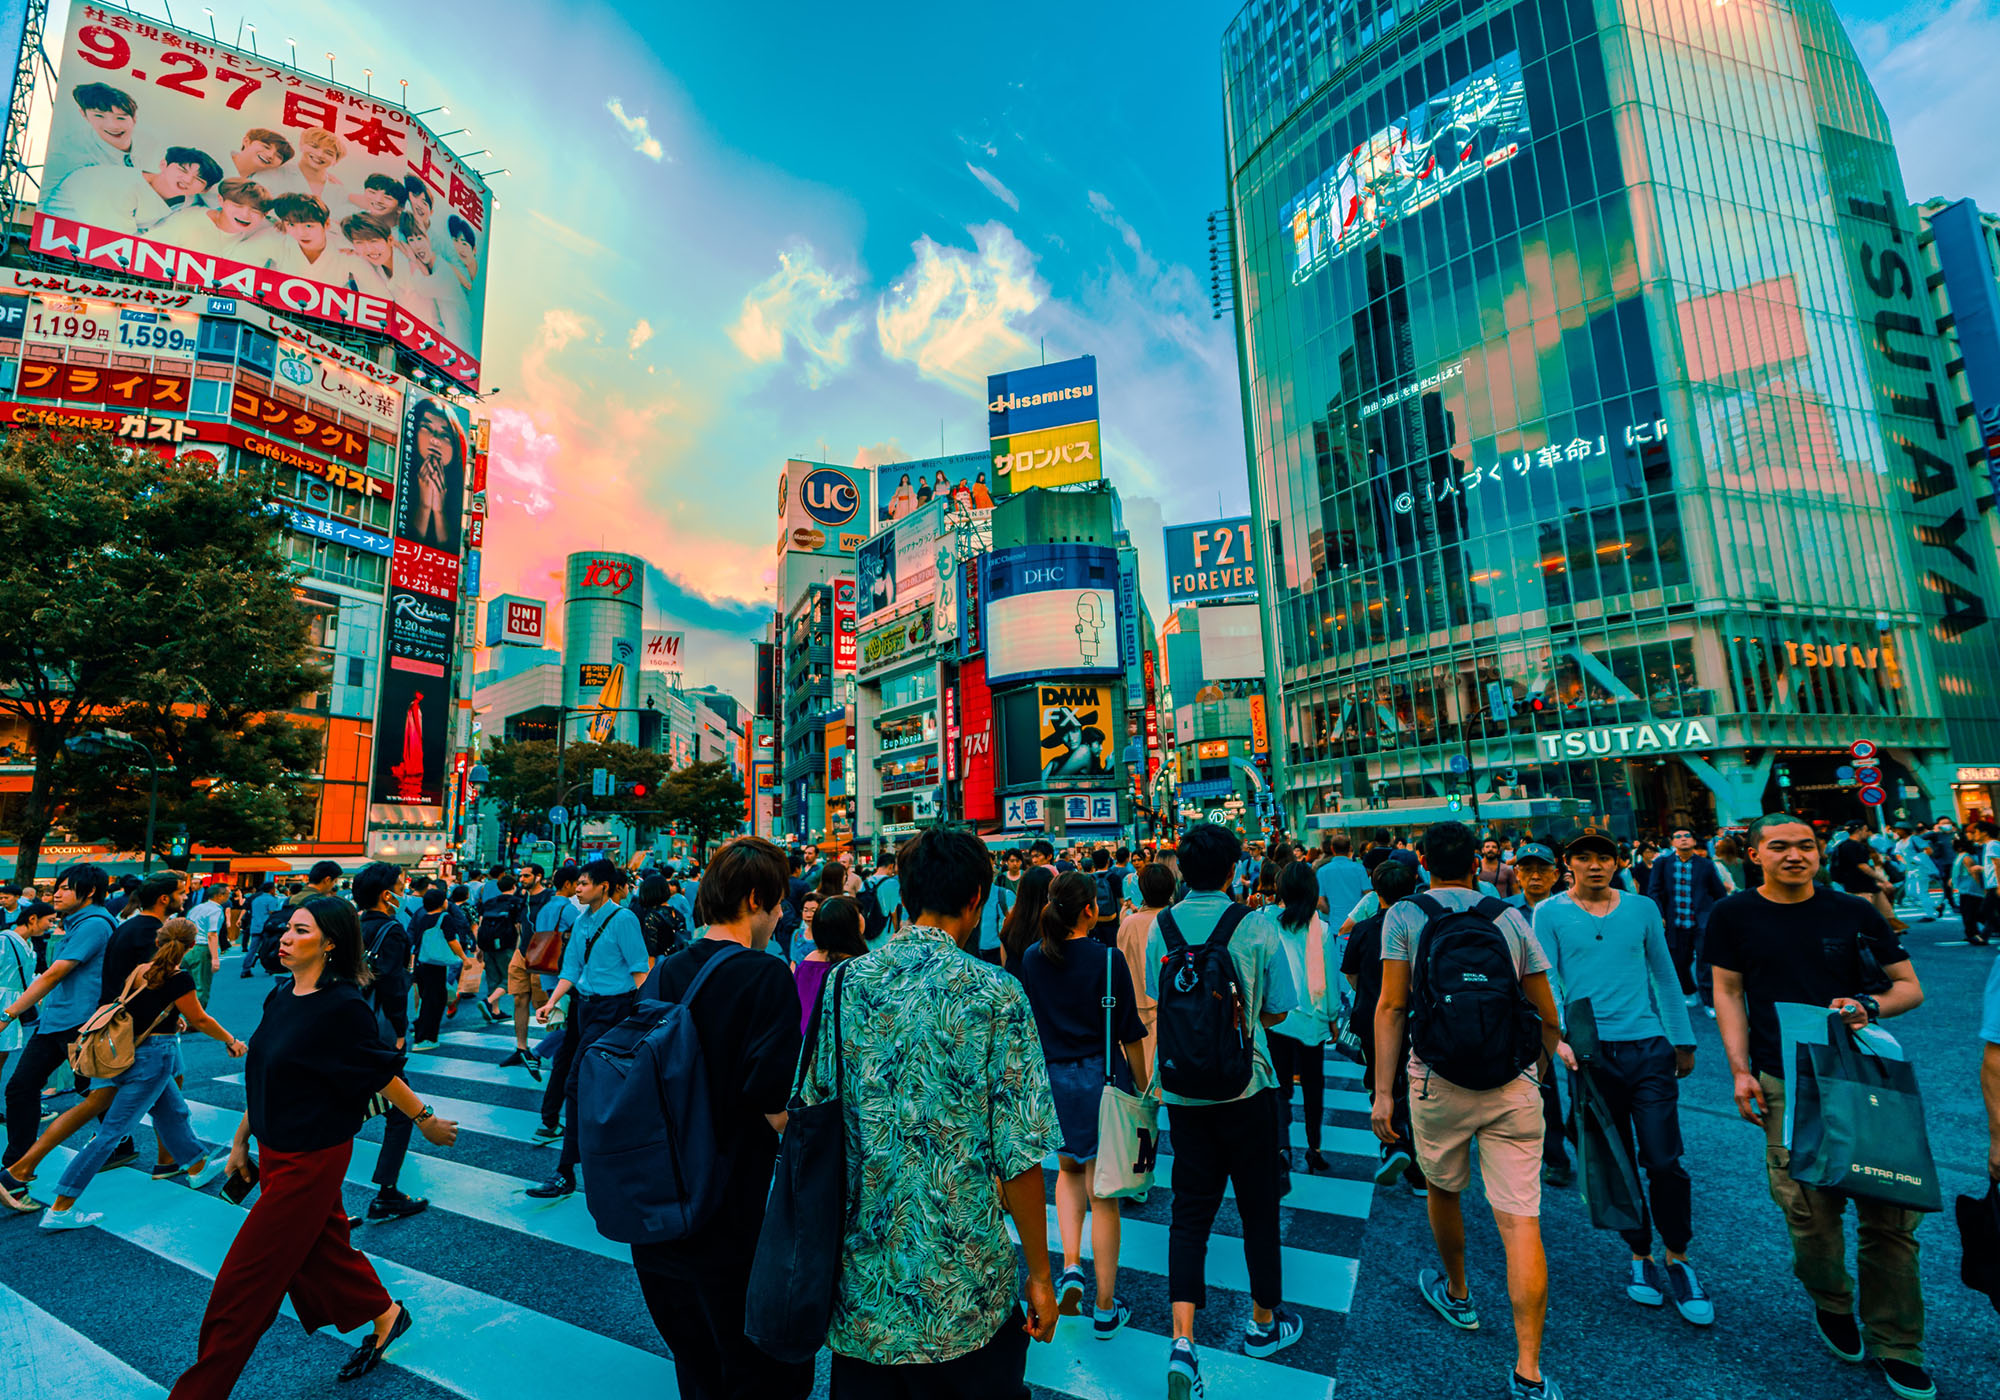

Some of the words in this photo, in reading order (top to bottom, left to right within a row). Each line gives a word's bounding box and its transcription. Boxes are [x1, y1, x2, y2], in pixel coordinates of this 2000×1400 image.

[77, 25, 262, 111] 9.27
[14, 271, 193, 308] しゃぶしゃぶバイキング
[33, 313, 110, 342] 1,199円
[119, 322, 195, 351] 1,599円
[268, 315, 399, 385] しゃぶしゃぶバイキング
[395, 311, 479, 378] ワナワン
[24, 366, 183, 402] プライス
[988, 385, 1094, 413] Hisamitsu
[118, 414, 197, 442] ガスト
[233, 390, 363, 454] コンタクト
[1849, 190, 1988, 638] TSUTAYA
[994, 441, 1093, 476] サロンパス
[325, 463, 383, 497] ガスト
[395, 544, 458, 569] ユリゴコロ
[580, 564, 633, 596] 109
[1024, 567, 1064, 585] DHC
[1173, 565, 1256, 594] FOREVER
[511, 619, 538, 633] QLO
[512, 607, 537, 618] UNI
[1125, 620, 1136, 667] neon
[1041, 688, 1100, 706] DMM
[1042, 707, 1082, 727] FX
[883, 732, 922, 750] Euphoria
[1542, 721, 1713, 758] TSUTAYA
[1066, 797, 1112, 818] 書店
[1852, 1164, 1894, 1179] G-STAR
[1896, 1173, 1922, 1186] RAW
